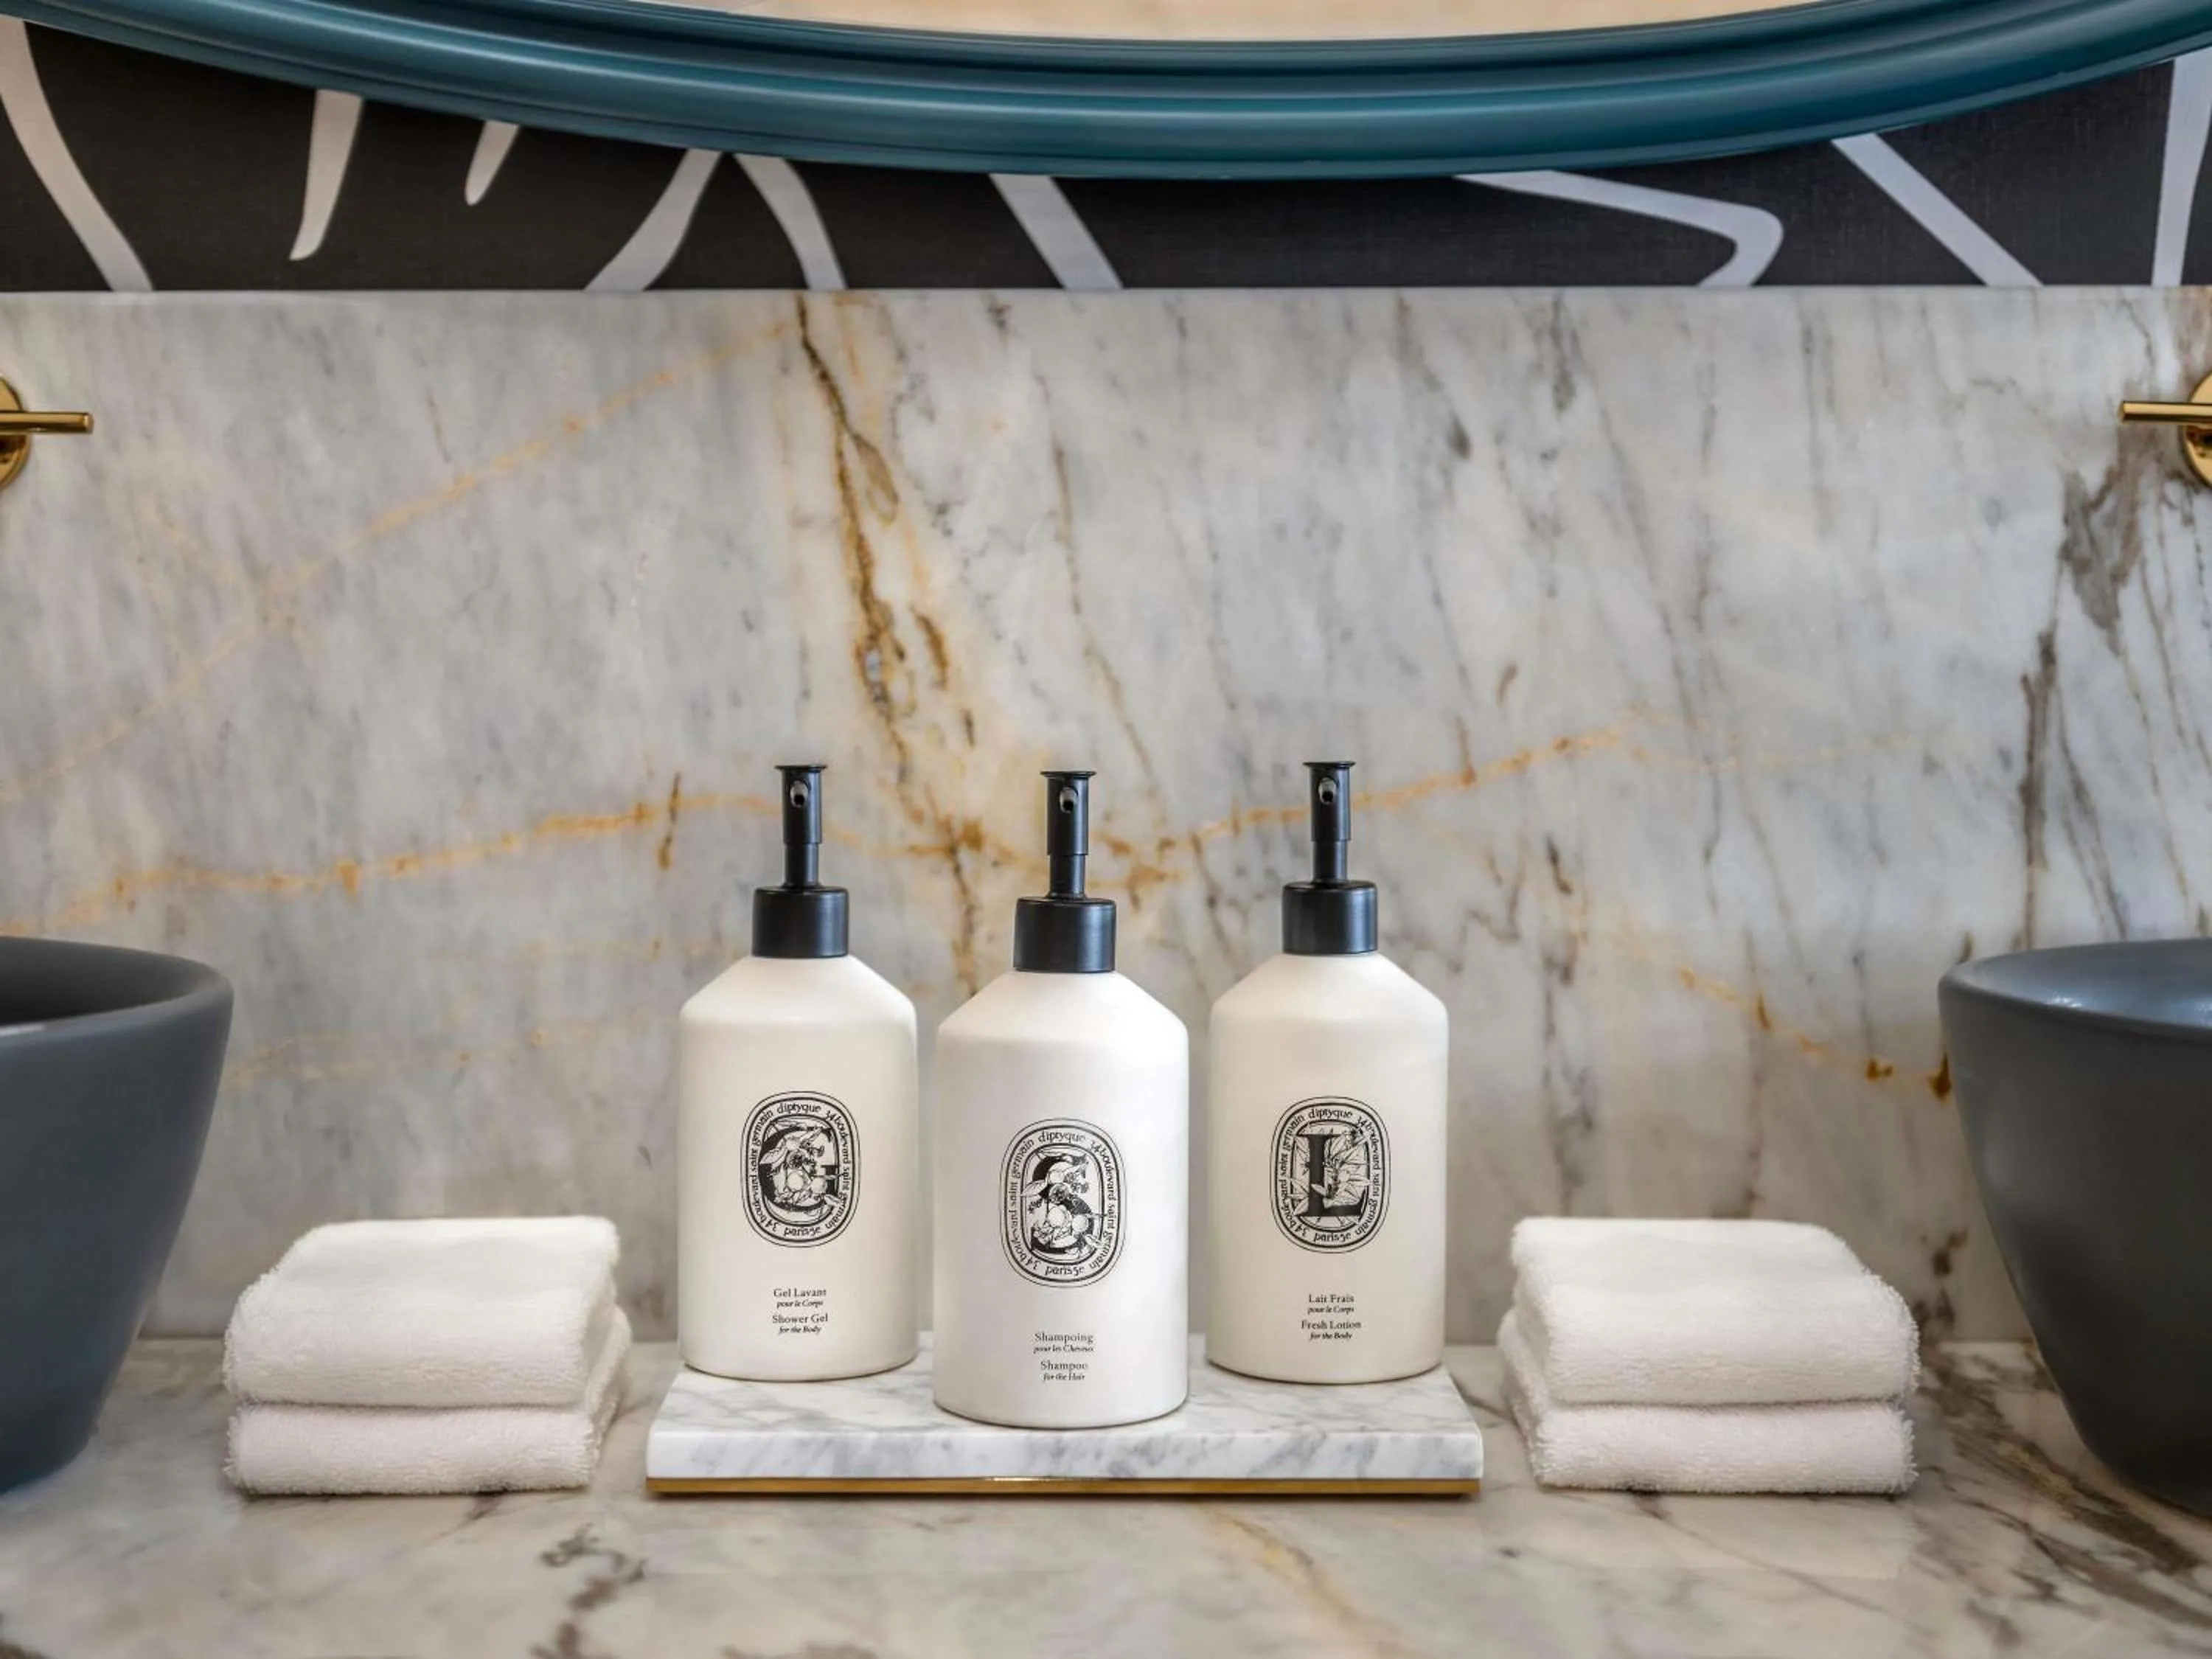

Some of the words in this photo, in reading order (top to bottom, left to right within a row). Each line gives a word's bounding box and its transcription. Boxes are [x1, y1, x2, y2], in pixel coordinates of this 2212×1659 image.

[776, 1103, 822, 1114] diptyque
[1308, 1107, 1353, 1118] diptyque
[1038, 1130, 1085, 1143] diptyque
[1295, 1134, 1366, 1217] L
[773, 1287, 791, 1297] Gel
[794, 1287, 827, 1297] Lavant
[1309, 1294, 1326, 1303] Lait
[1329, 1294, 1354, 1303] Frais
[772, 1314, 809, 1324] Shower
[810, 1312, 828, 1324] Gel
[1301, 1320, 1327, 1329] Fresh
[1329, 1321, 1361, 1329] Lotion
[1034, 1331, 1094, 1345] Shampoing
[1040, 1360, 1088, 1371] Shampoo
